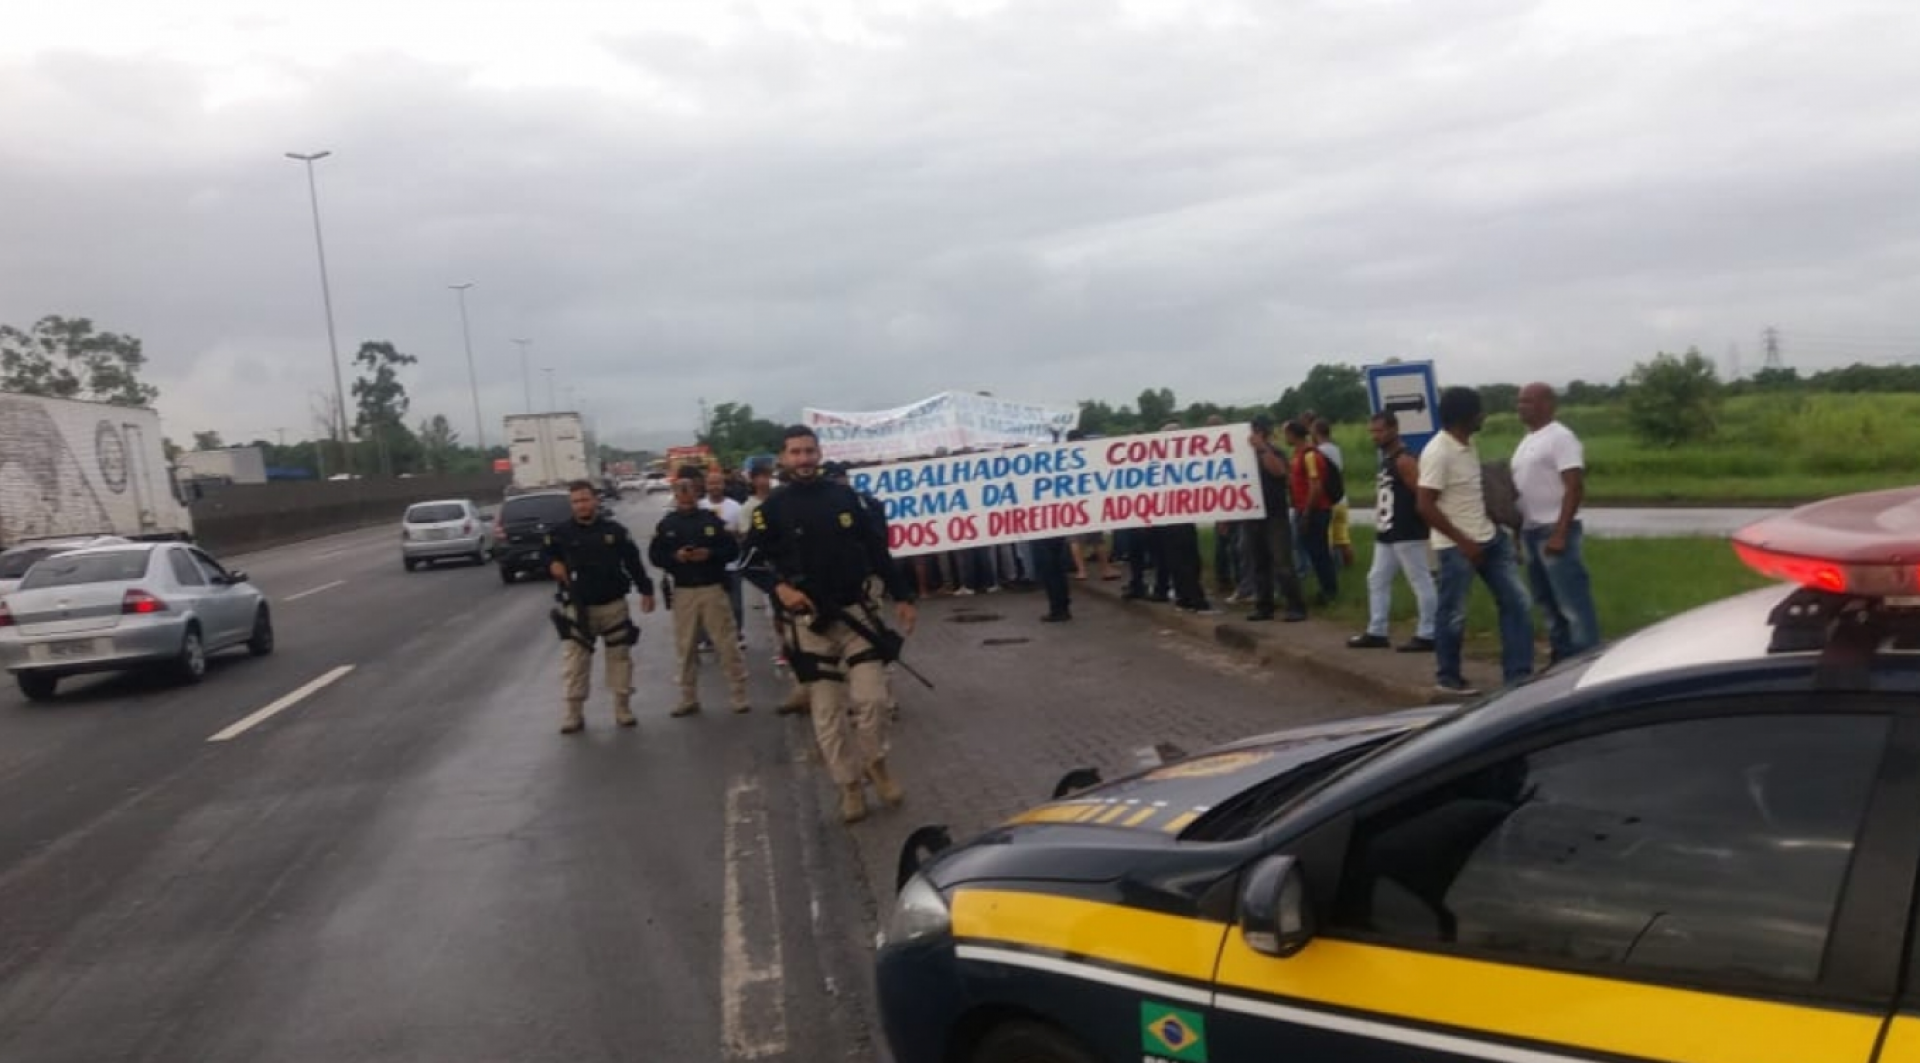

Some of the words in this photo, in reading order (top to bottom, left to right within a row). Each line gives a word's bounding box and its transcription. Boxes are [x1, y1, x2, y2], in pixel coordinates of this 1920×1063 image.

[982, 482, 1018, 506] DA
[1033, 457, 1248, 500] PREVIDÊNCIA.
[1106, 433, 1234, 485] CONTRA
[947, 514, 978, 543] OS
[987, 498, 1090, 537] DIREITOS
[1100, 484, 1259, 528] ADQUIRIDOS.
